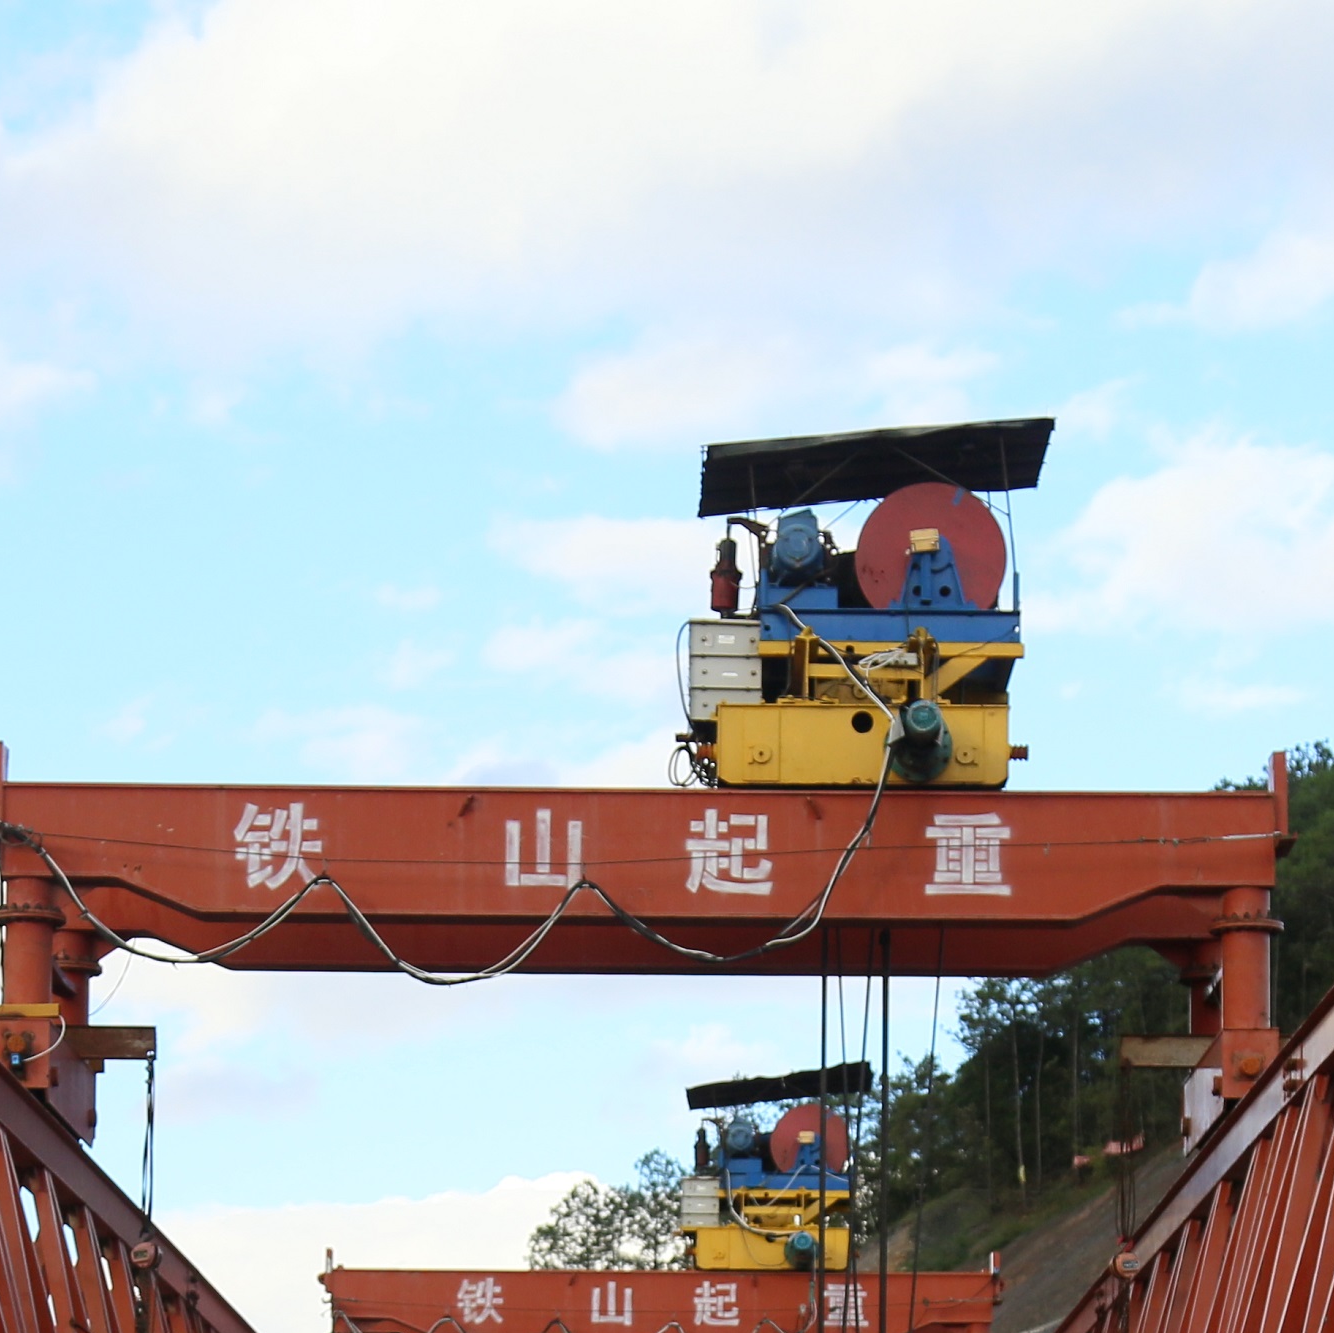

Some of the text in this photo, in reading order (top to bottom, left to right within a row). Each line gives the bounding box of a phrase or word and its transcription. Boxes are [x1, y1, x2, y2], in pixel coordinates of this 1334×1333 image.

[233, 802, 1013, 896] 铁山起重
[456, 1277, 870, 1328] 铁山起重
